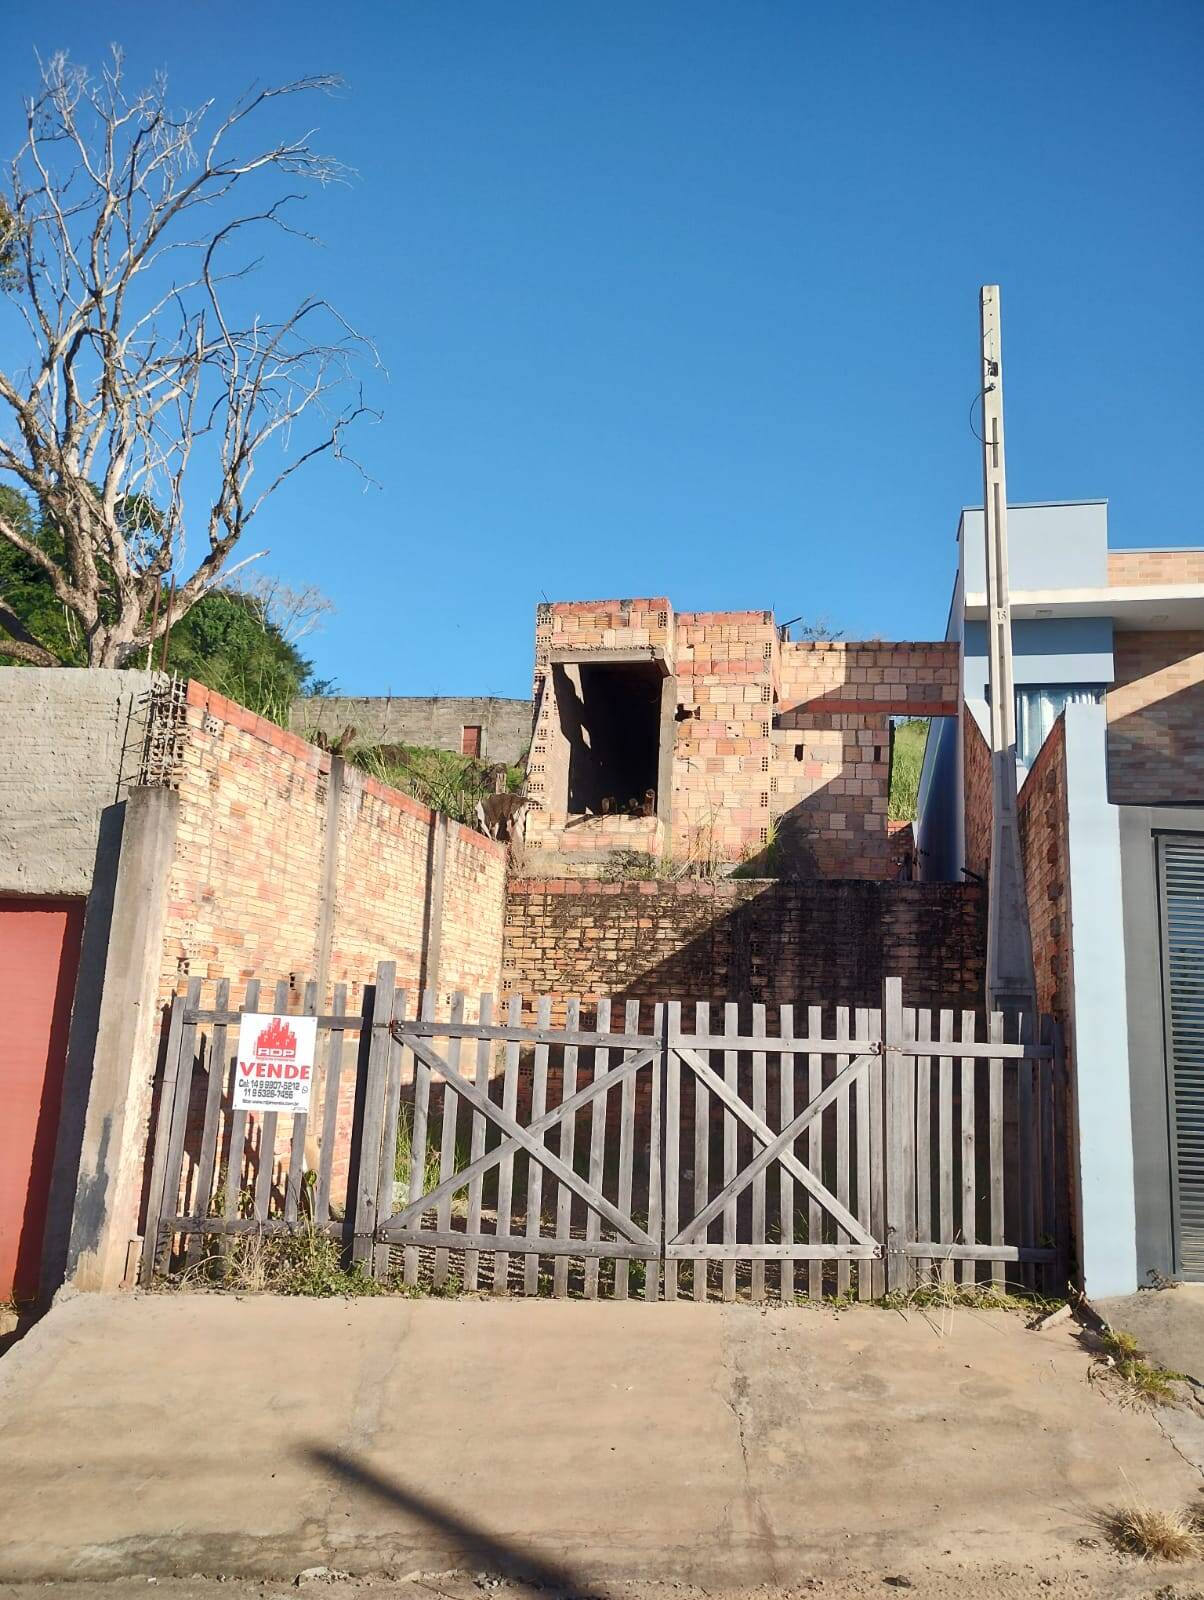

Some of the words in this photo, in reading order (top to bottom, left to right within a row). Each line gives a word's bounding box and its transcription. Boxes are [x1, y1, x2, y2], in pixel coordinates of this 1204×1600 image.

[258, 1047, 295, 1056] RDP
[240, 1062, 311, 1079] VENDE
[251, 1079, 259, 1089] 14
[243, 1088, 251, 1097] 11
